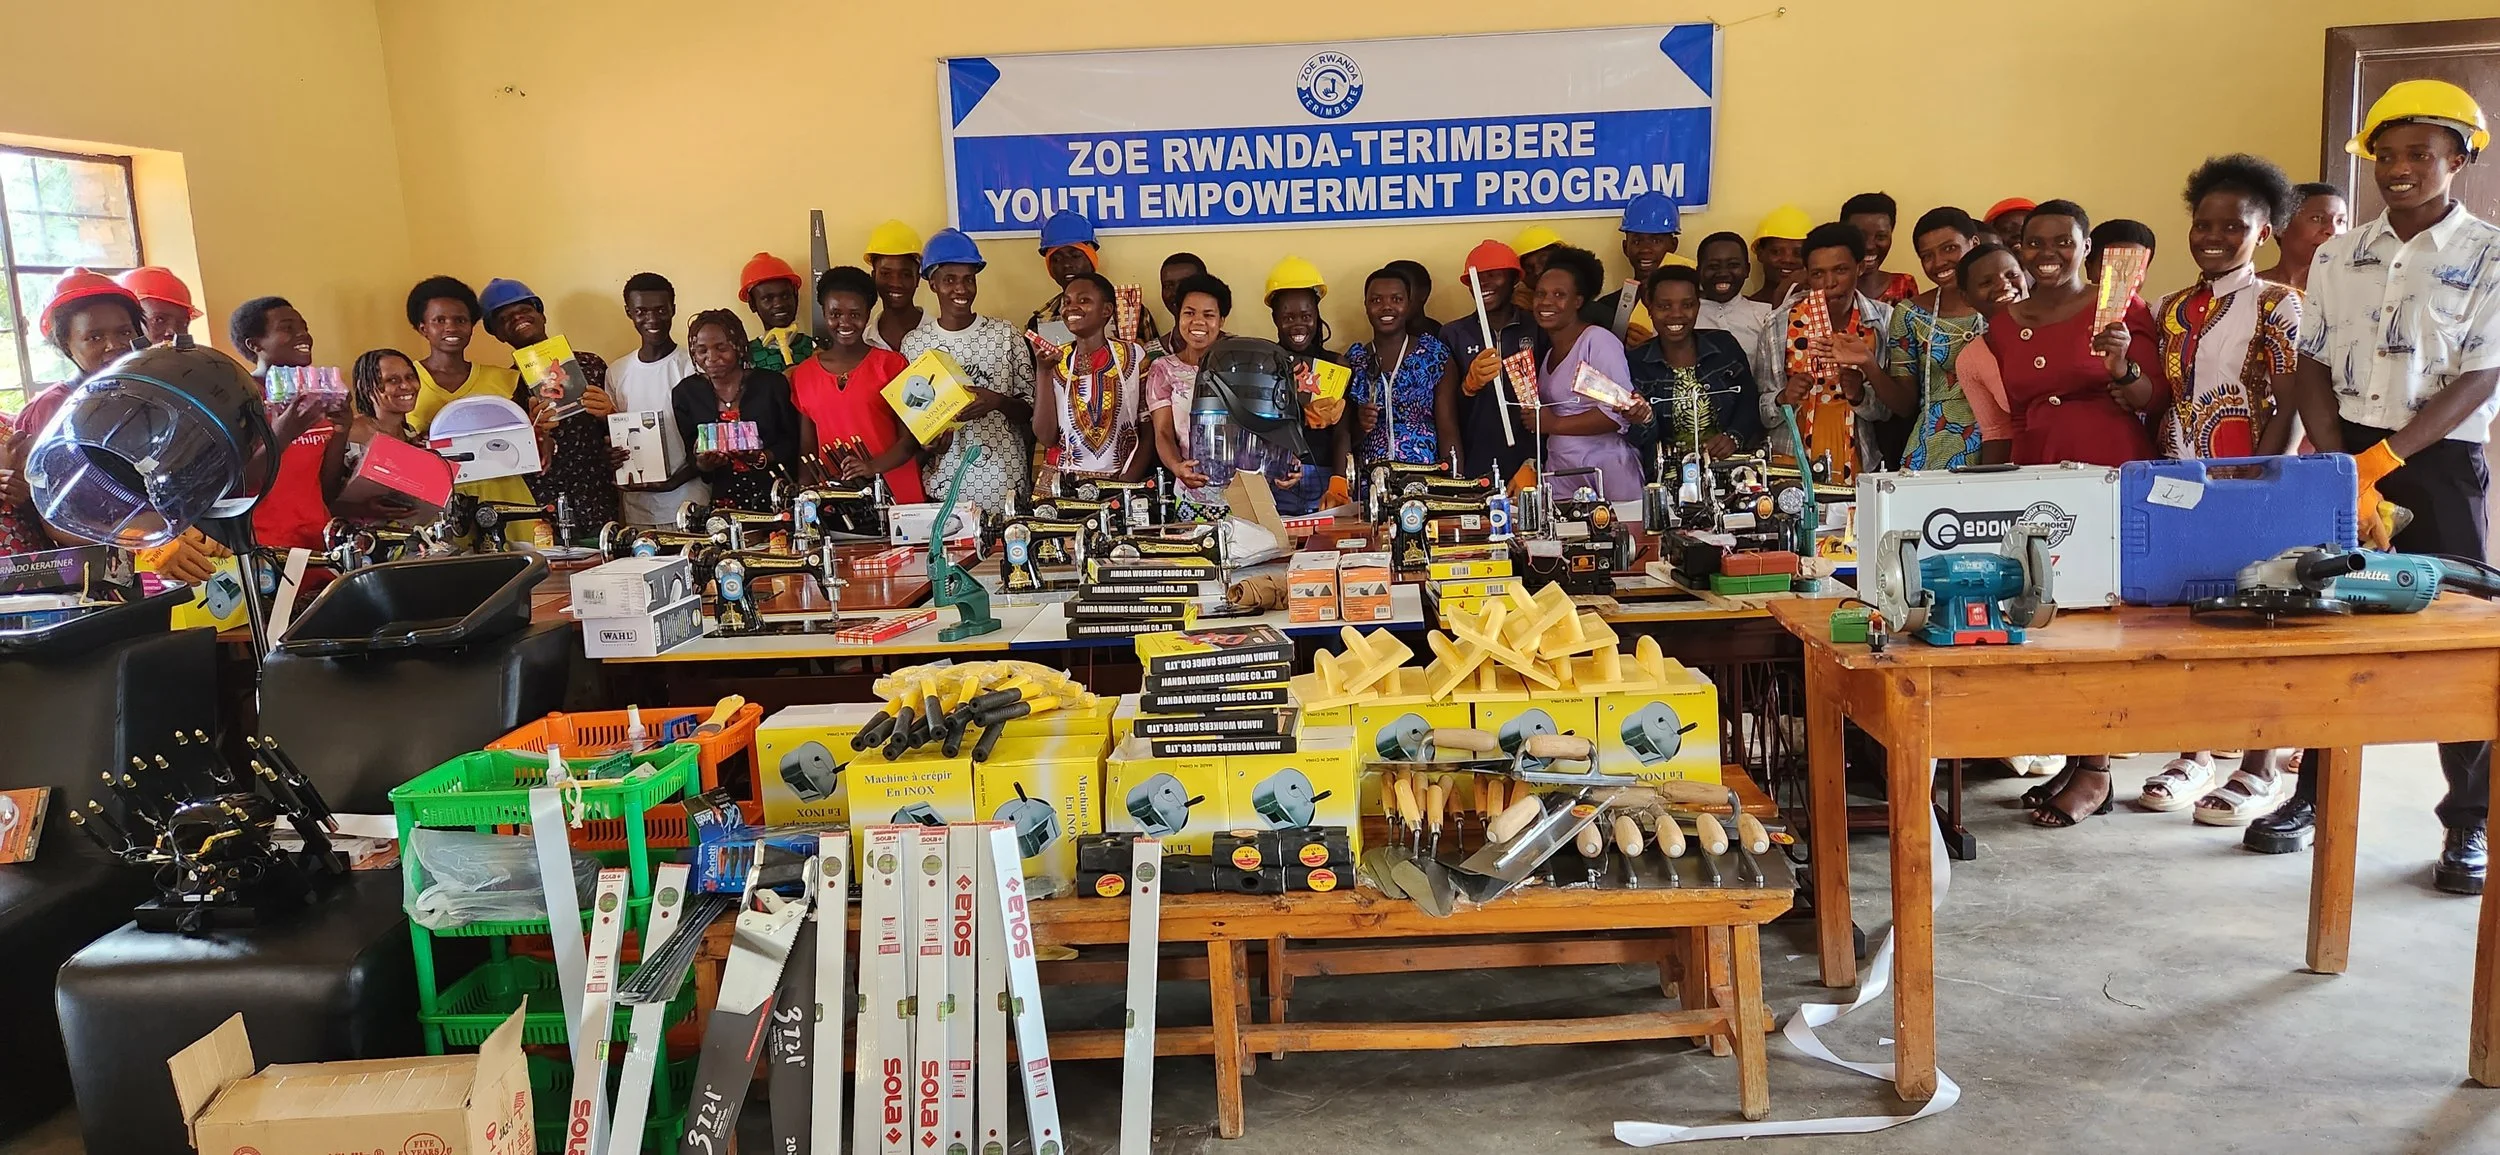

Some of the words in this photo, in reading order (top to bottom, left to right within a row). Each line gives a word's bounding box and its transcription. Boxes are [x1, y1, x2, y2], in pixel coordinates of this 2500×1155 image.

[1301, 61, 1317, 81] ZOE
[1319, 54, 1358, 81] RWANDA
[1302, 90, 1358, 115] TERIMBERE
[1067, 138, 1150, 177] ZOE
[1162, 121, 1596, 174] RWANDA-TERIMBERE
[984, 186, 1125, 223] YOUTH
[1139, 173, 1462, 219] EMPOWERMENT
[1475, 162, 1686, 207] PROGRAM
[2039, 505, 2063, 520] QUALITY
[30, 558, 73, 571] KERATINER
[603, 632, 633, 640] WAHL
[1193, 657, 1216, 667] GAUGE
[1218, 654, 1252, 664] WORKERS
[1254, 651, 1279, 661] JIANDA
[1161, 676, 1187, 687] JIANDA
[1188, 674, 1224, 685] WORKERS
[1226, 672, 1249, 682] GAUGE
[1157, 696, 1182, 705] JIANDA
[1184, 694, 1220, 704] WORKERS
[1222, 692, 1245, 702] GAUGE
[1175, 722, 1198, 732] GAUGE
[1200, 721, 1236, 730] WORKERS
[1238, 720, 1263, 729] JIANDA
[1193, 744, 1216, 753] GAUGE
[1218, 743, 1254, 752] WORKERS
[1255, 741, 1281, 750] JIANDA
[864, 773, 909, 784] Machine
[921, 770, 952, 782] crépir
[886, 787, 900, 797] En
[904, 786, 935, 796] INOX
[1078, 775, 1089, 819] Machine
[1065, 796, 1075, 810] En
[797, 808, 824, 817] INOX
[828, 808, 840, 816] En
[1066, 813, 1078, 843] INOX
[954, 893, 972, 957] SOLA
[1008, 894, 1031, 959] SOLA
[884, 1057, 902, 1124] SOLA
[921, 1060, 939, 1128] SOLA
[413, 1139, 435, 1149] FIVE
[786, 1137, 796, 1155] 20
